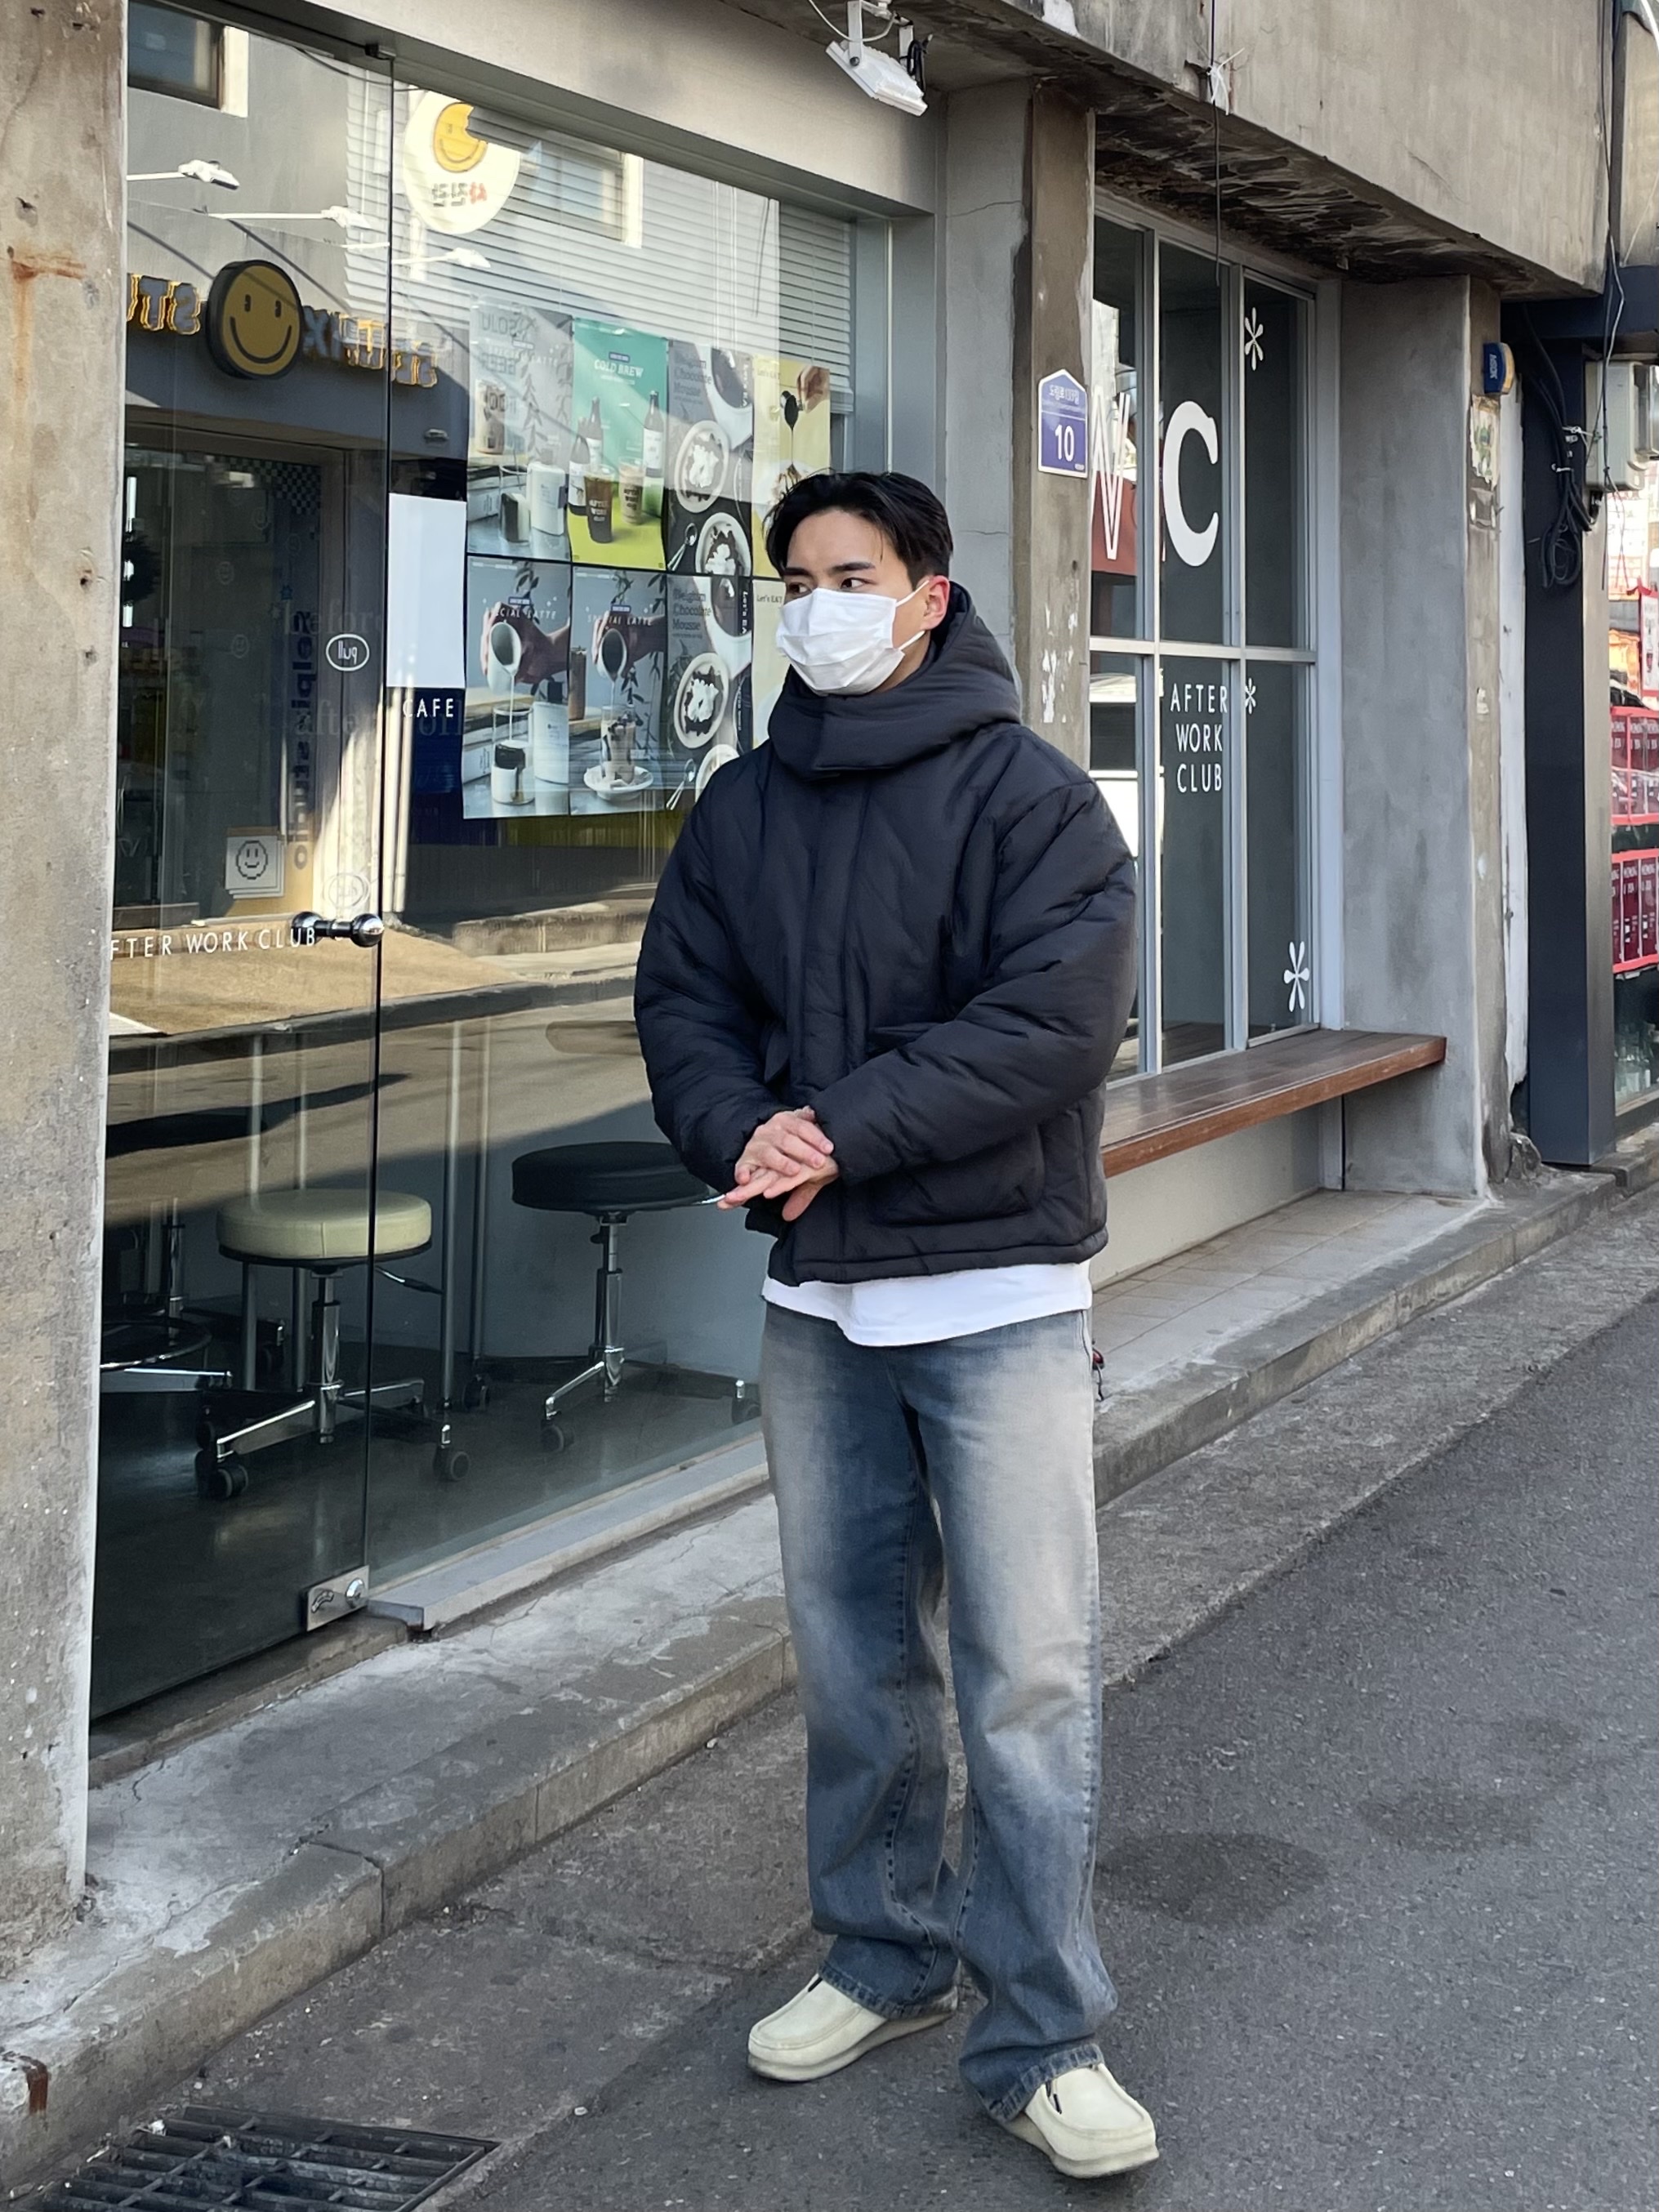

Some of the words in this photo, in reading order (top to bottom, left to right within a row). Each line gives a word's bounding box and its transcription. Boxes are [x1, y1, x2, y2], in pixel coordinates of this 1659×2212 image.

[594, 359, 618, 373] COLD
[618, 363, 644, 377] BREW
[1055, 424, 1075, 462] 10
[403, 698, 455, 718] CAFE
[1170, 683, 1228, 713] AFTER
[1175, 723, 1223, 752] WORK
[1177, 763, 1223, 792] CLUB
[109, 936, 172, 961] FTER
[186, 930, 249, 955] WORK
[257, 926, 316, 950] CLUB
